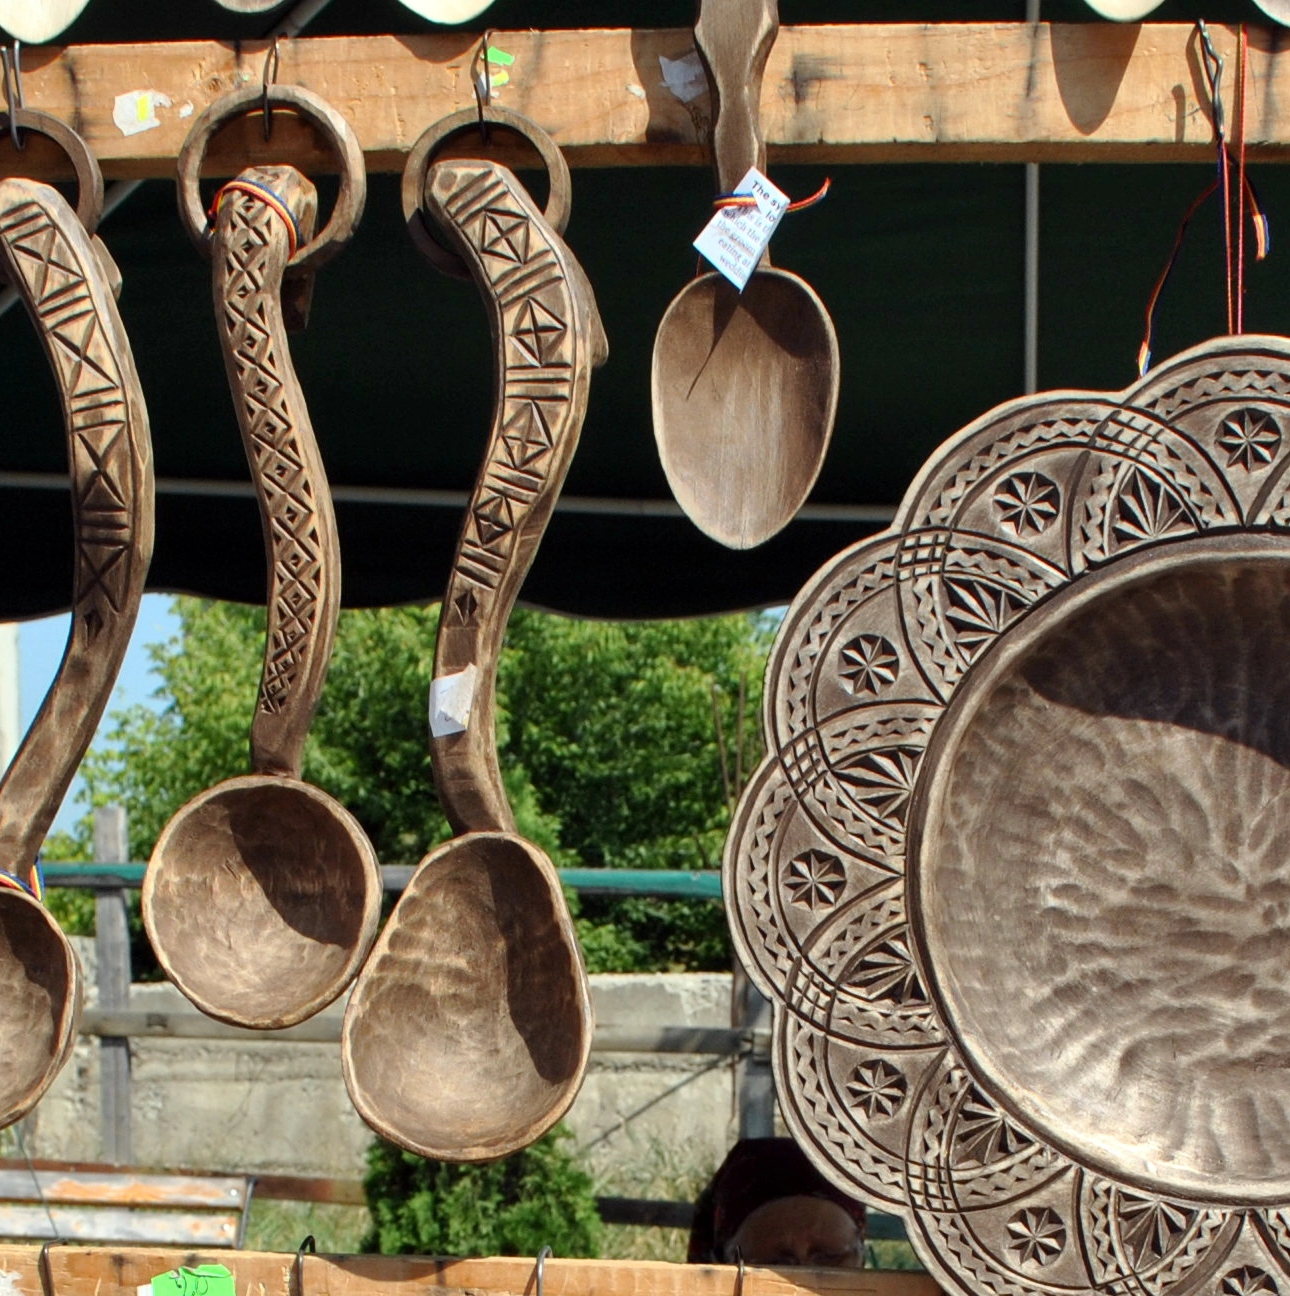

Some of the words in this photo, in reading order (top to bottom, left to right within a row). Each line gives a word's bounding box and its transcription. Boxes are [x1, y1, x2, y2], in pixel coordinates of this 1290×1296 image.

[752, 180, 769, 200] The
[717, 220, 731, 235] the
[748, 229, 761, 242] the
[718, 239, 742, 261] eating
